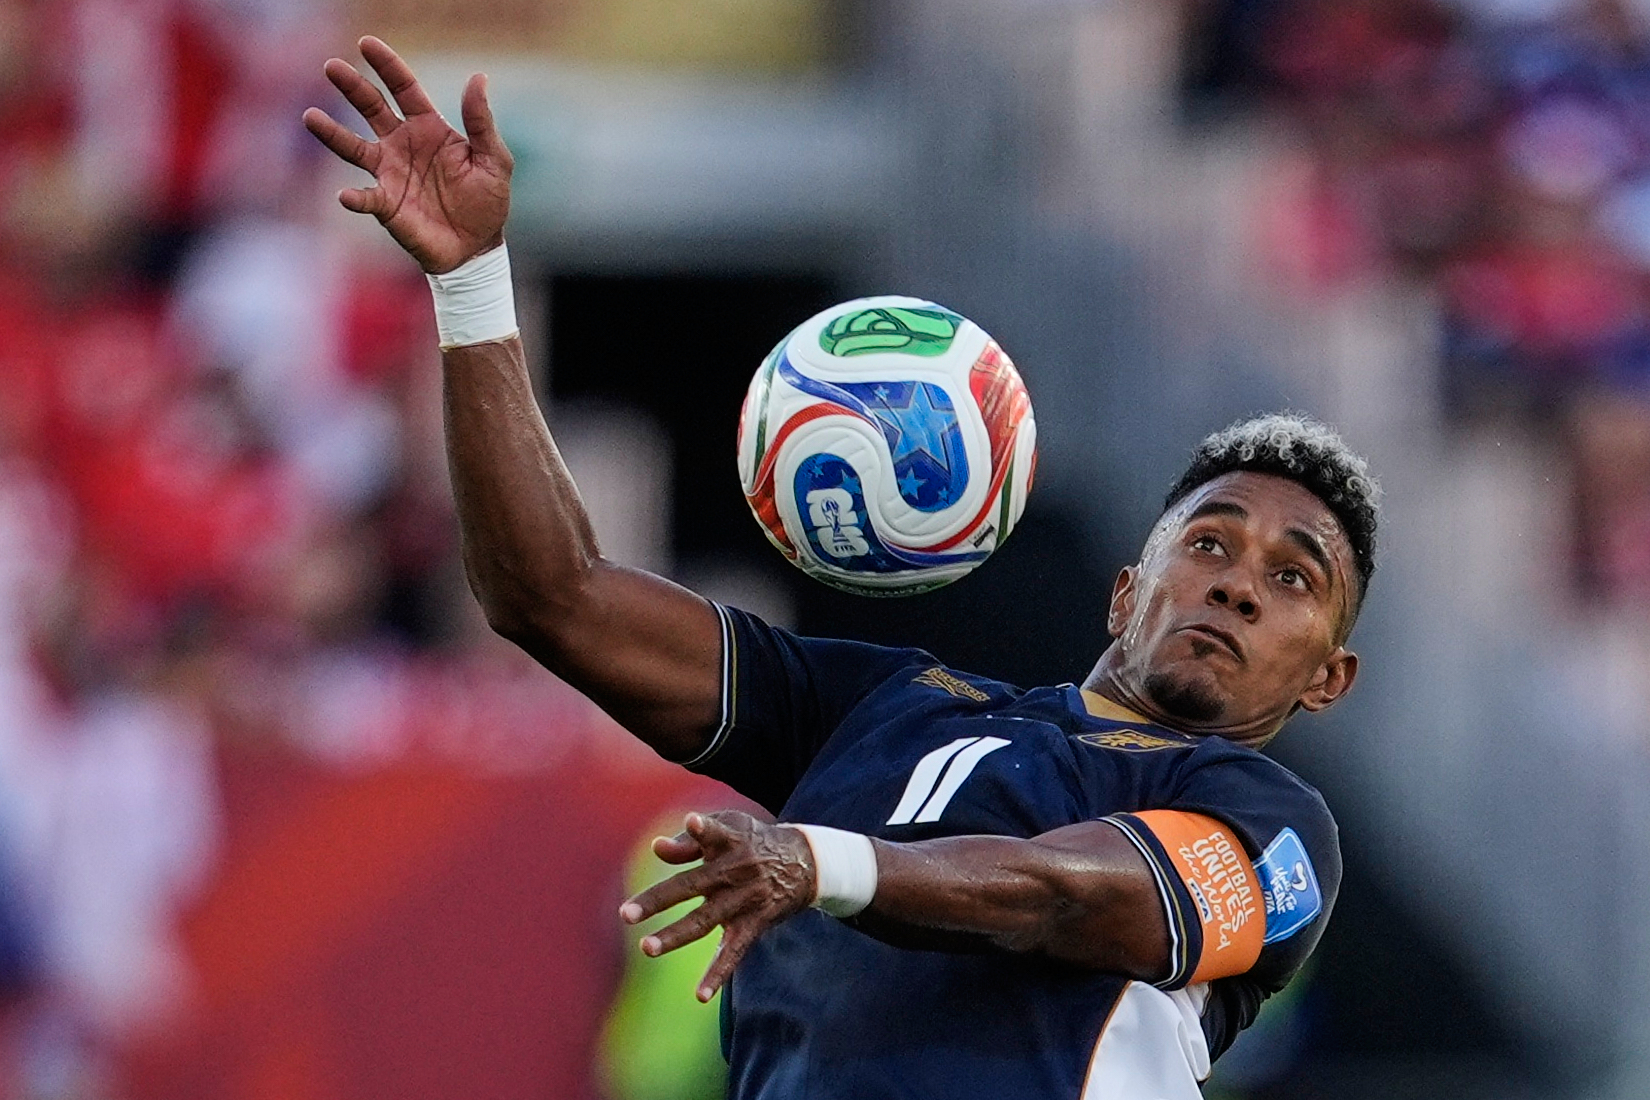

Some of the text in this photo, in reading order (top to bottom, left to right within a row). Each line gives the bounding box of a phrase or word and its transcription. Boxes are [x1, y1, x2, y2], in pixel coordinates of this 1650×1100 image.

[885, 736, 1013, 827] 11
[1178, 841, 1231, 952] the World
[1189, 880, 1211, 921] FIFA
[1192, 838, 1246, 933] UNITES
[1208, 831, 1256, 923] FOOTBALL
